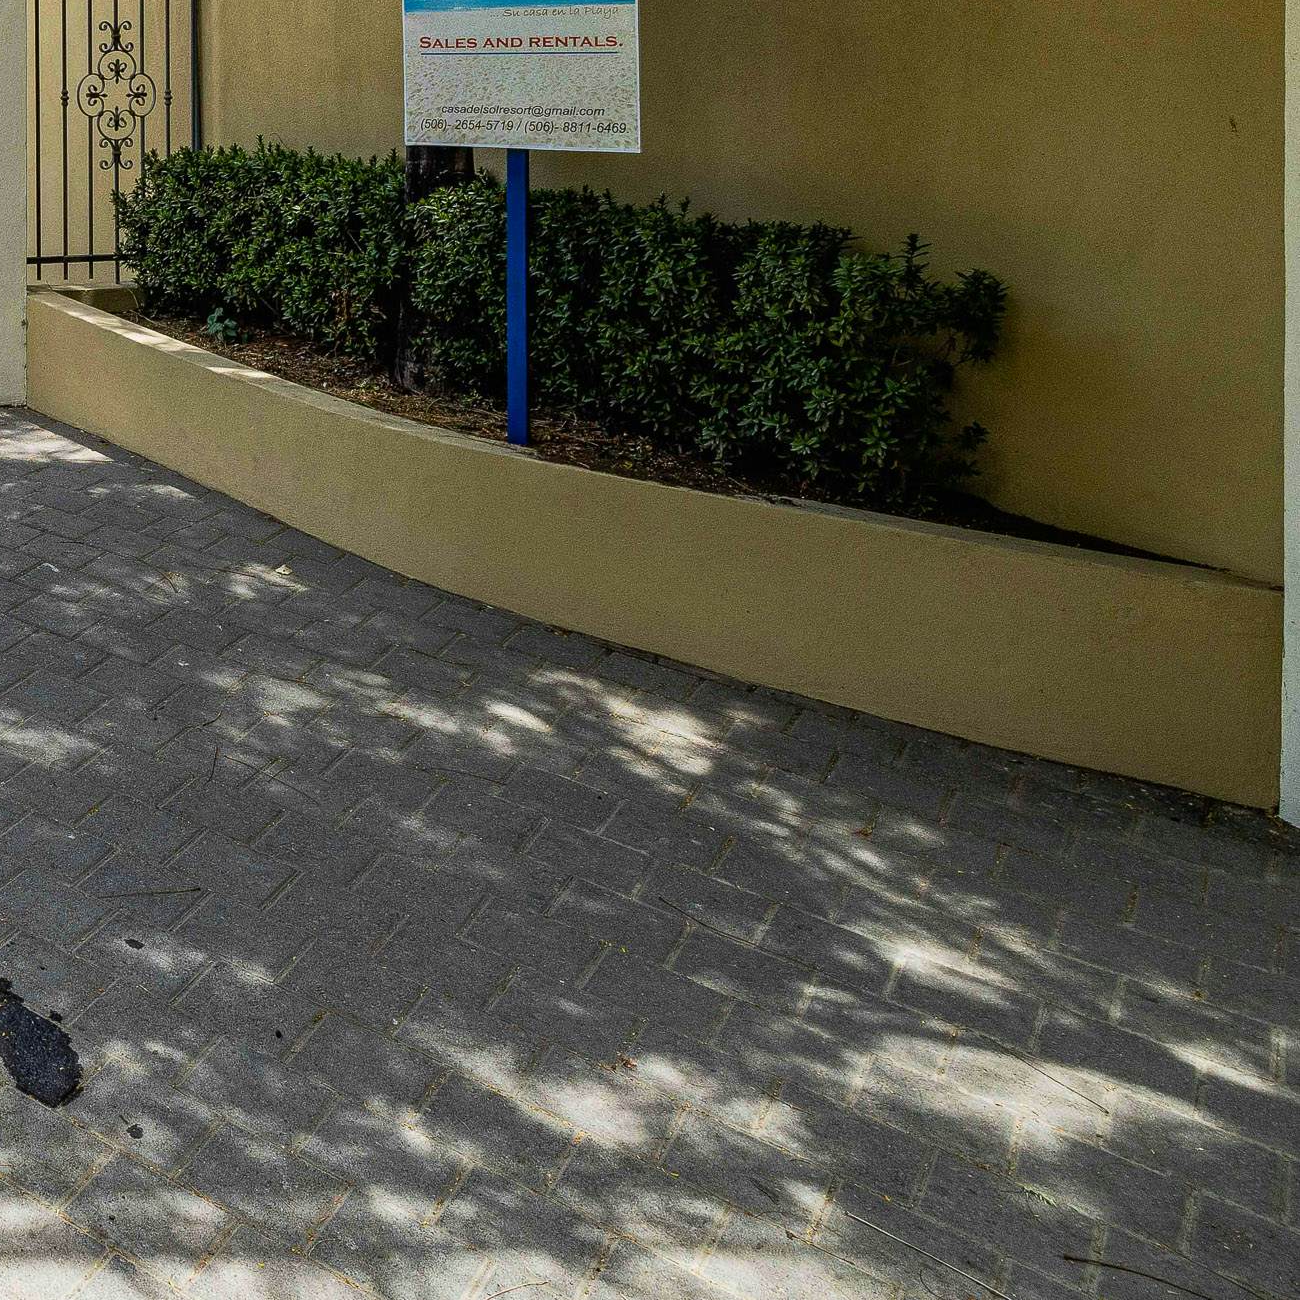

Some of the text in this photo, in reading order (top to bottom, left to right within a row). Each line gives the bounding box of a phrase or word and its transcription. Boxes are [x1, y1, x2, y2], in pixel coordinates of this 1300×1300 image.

[503, 8, 520, 17] Su
[523, 7, 549, 17] casa
[552, 7, 566, 17] en
[568, 5, 581, 16] la
[584, 5, 620, 19] Playa
[419, 35, 624, 49] SALES AND RENTALS.
[441, 104, 606, 118] casadelsolresort@gmail.com
[420, 119, 452, 131] (506)-
[454, 119, 515, 131] 2654-5719
[524, 121, 560, 134] (506)-
